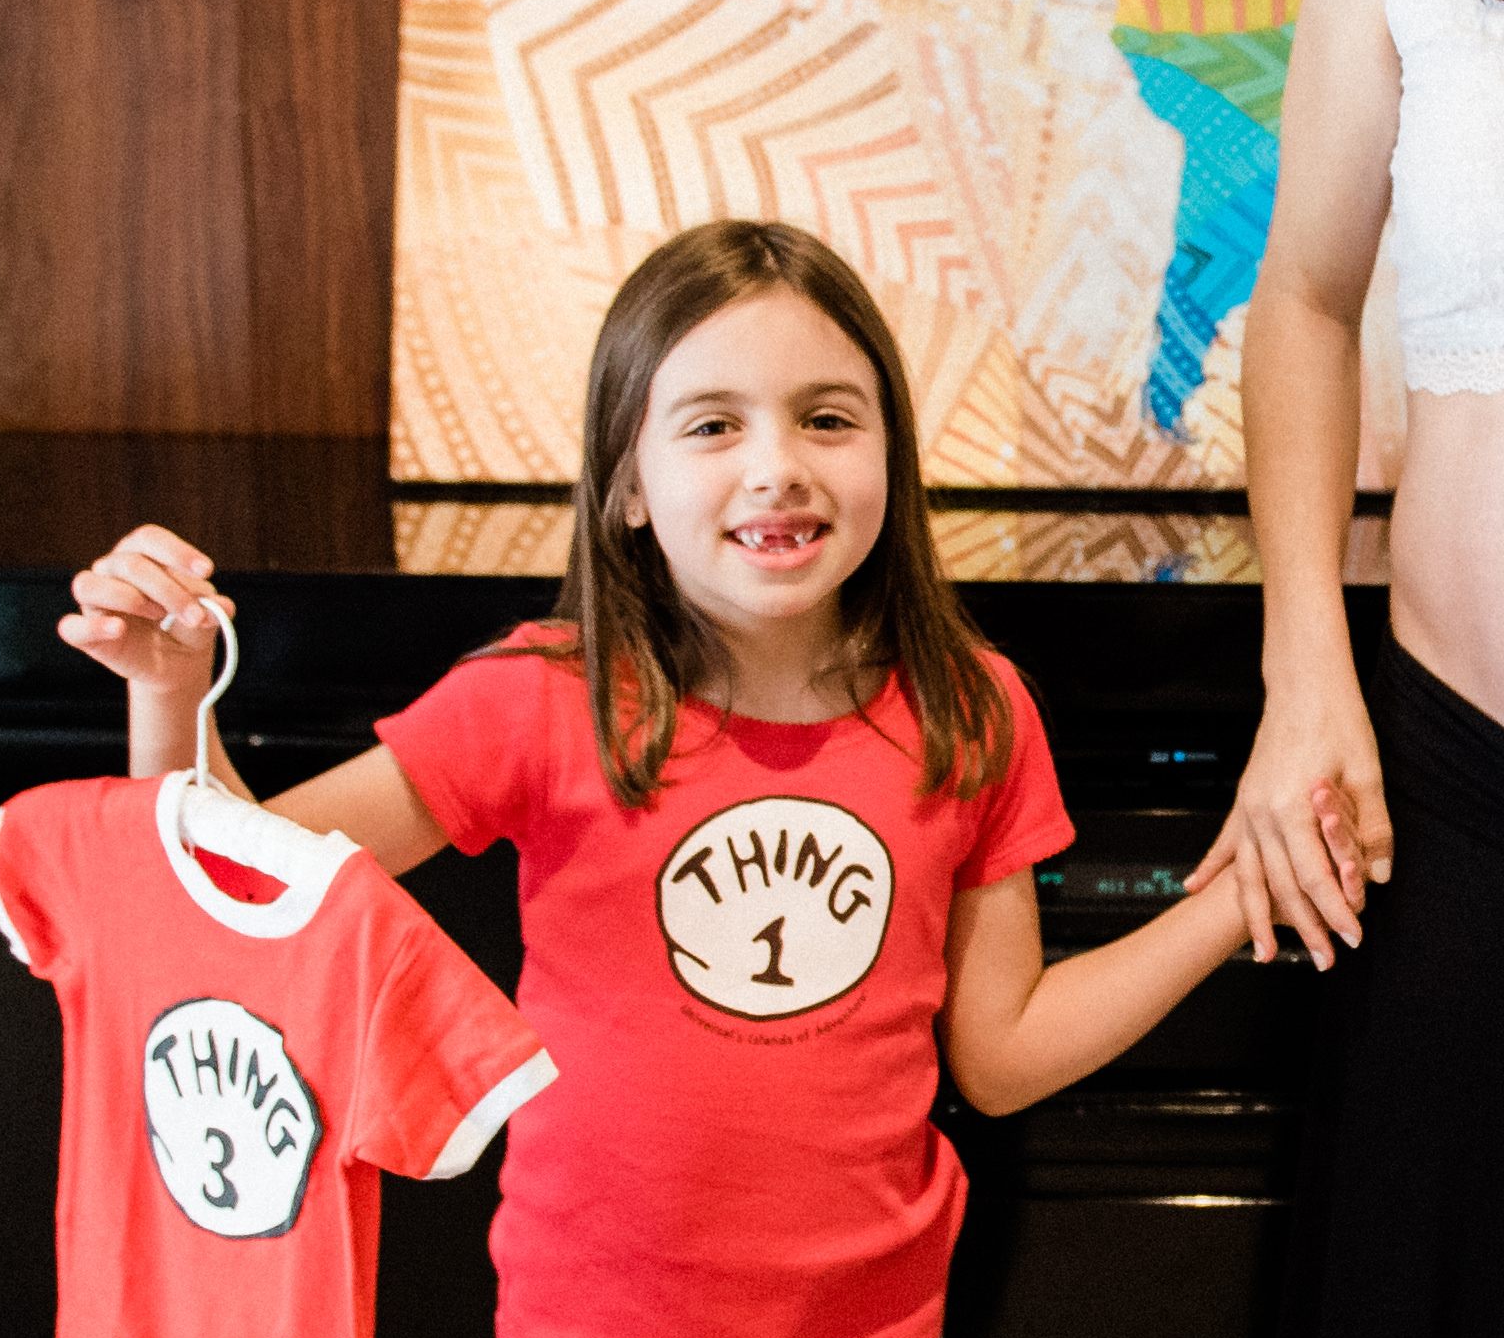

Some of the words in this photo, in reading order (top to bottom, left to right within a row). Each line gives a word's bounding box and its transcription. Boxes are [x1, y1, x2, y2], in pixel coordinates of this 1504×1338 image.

[671, 828, 874, 924] THING
[751, 915, 795, 987] 1
[152, 1028, 301, 1157] THING
[202, 1127, 239, 1211] 3
